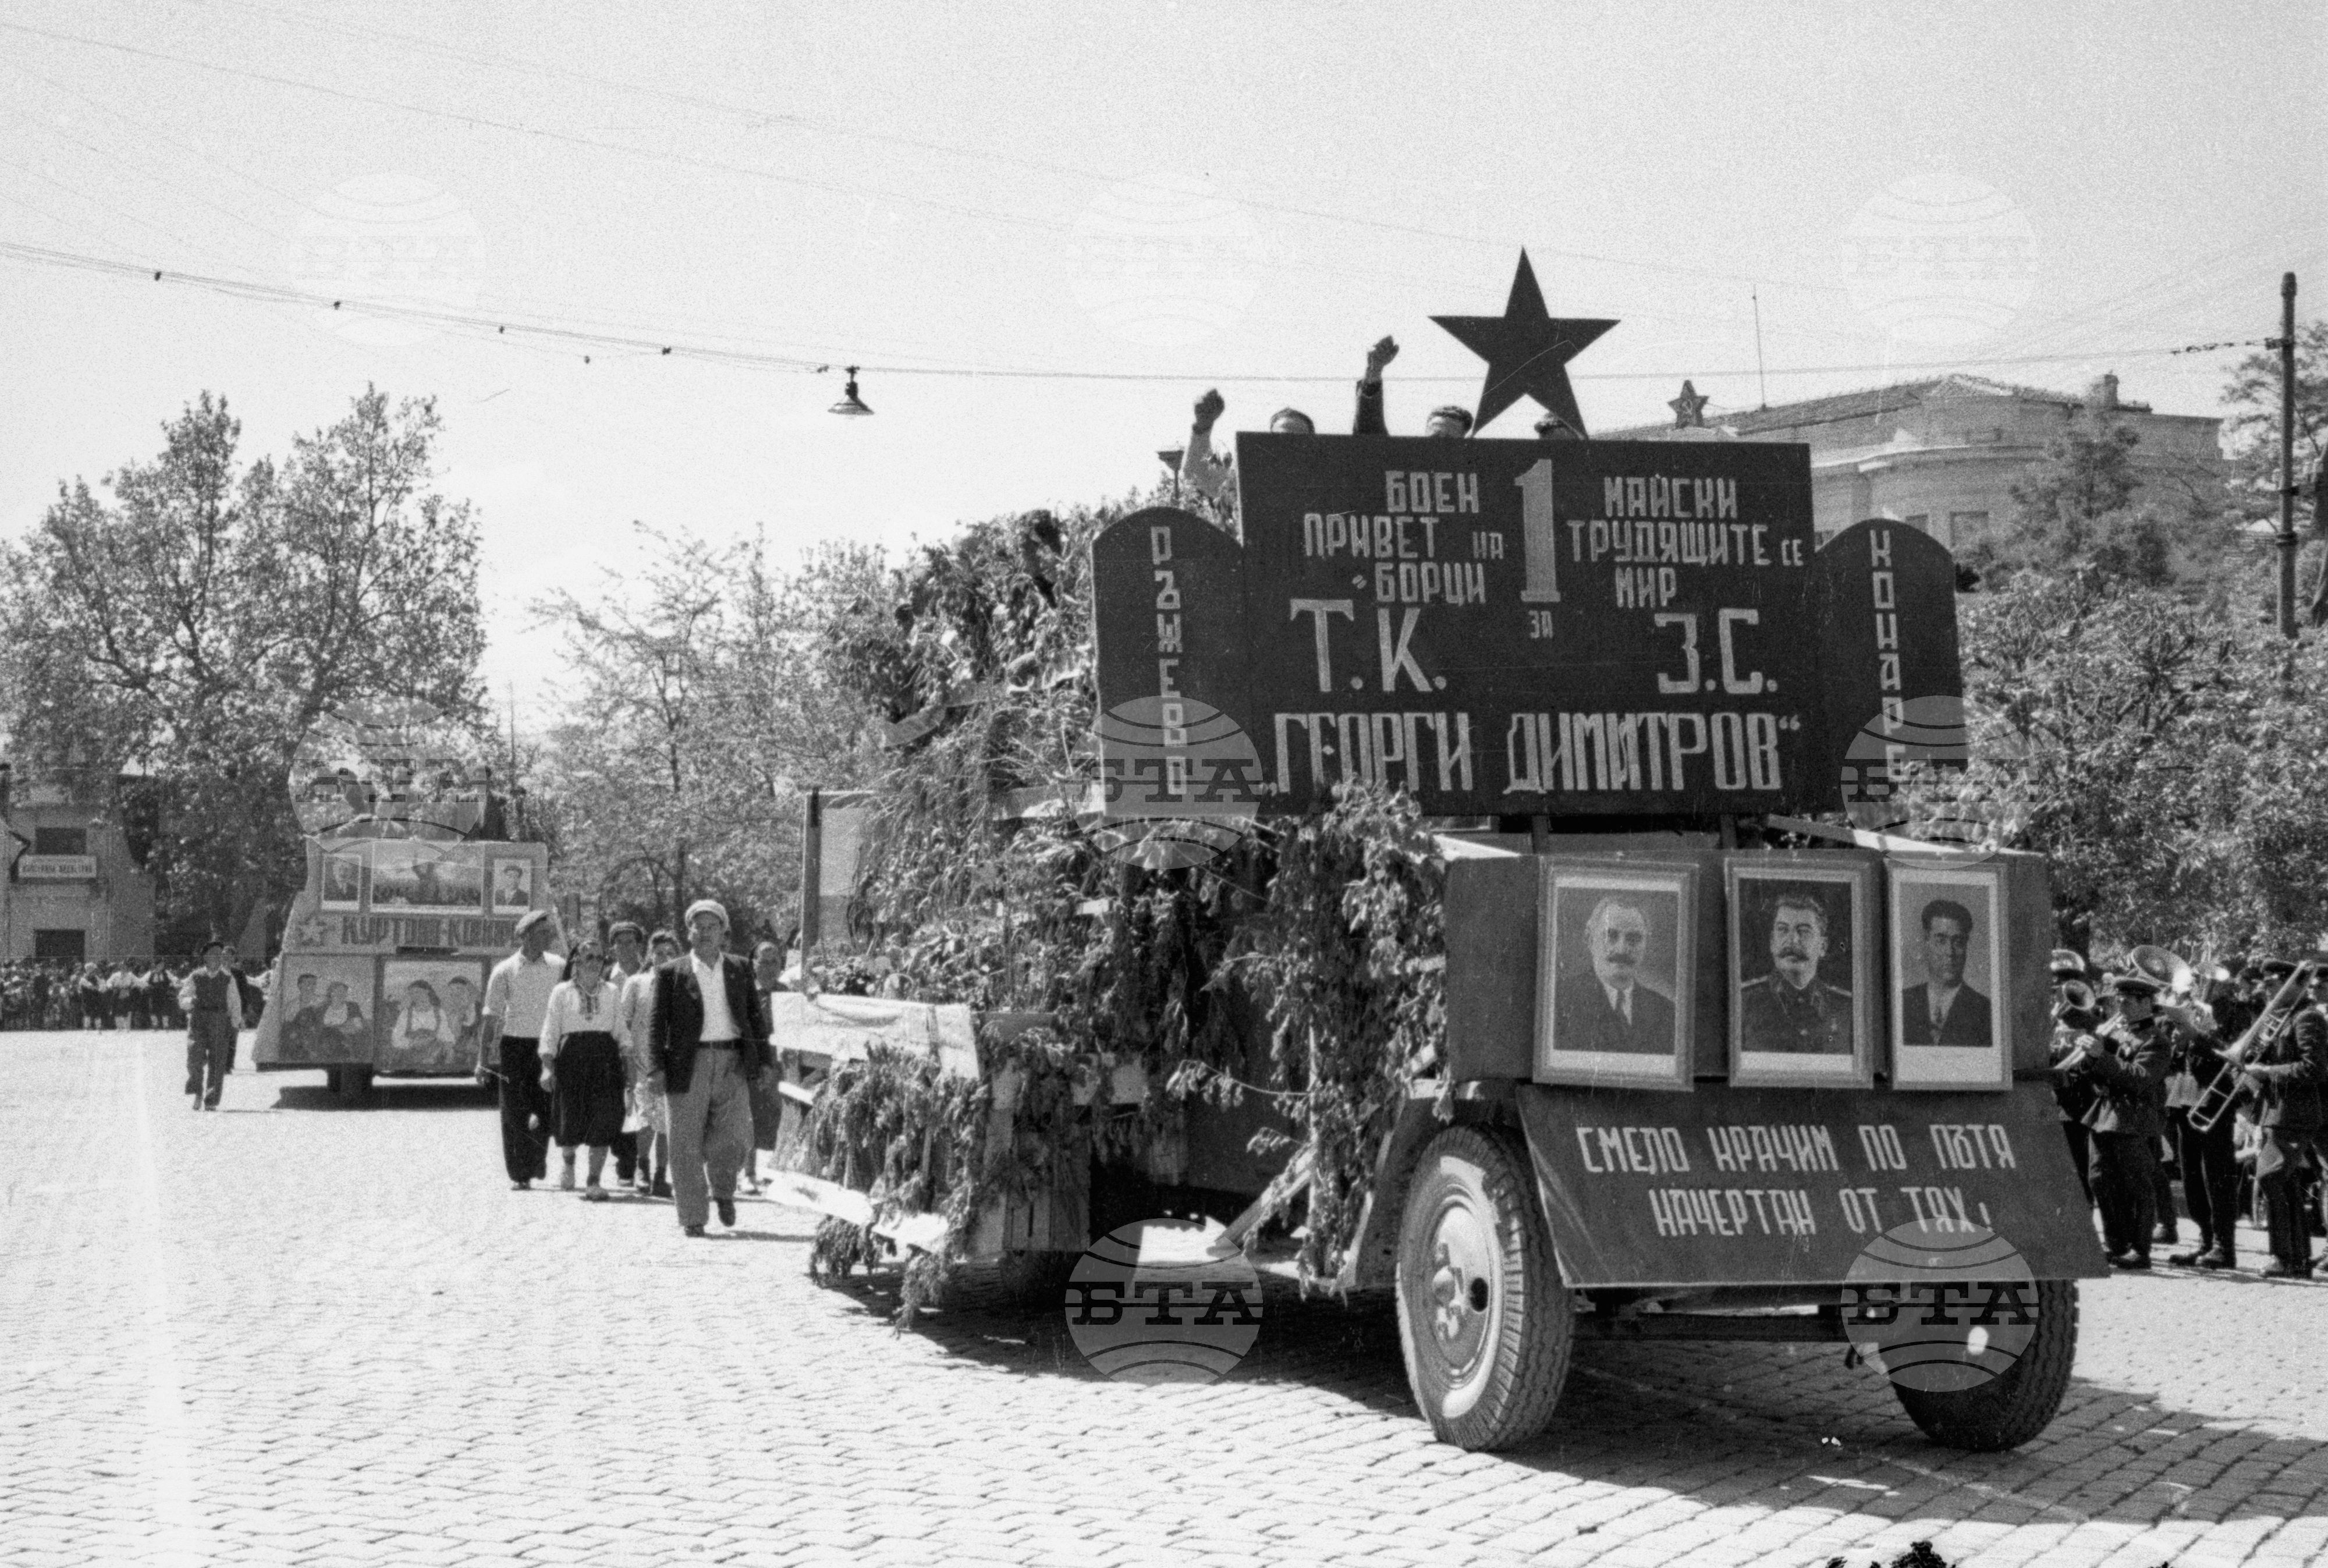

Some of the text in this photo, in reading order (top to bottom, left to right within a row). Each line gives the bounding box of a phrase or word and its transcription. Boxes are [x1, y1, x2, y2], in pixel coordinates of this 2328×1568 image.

[1304, 513, 1803, 566] ПРИВЕТ НА ТРУДЯЩИТЕ СЕ
[1386, 459, 1737, 602] БОЕН 1 МАЙСКИ
[1529, 611, 1553, 638] ЗА
[1615, 567, 1676, 608] МИР
[1151, 526, 1187, 795] РАЖЕВО
[1870, 529, 1906, 782] КОНАРЕ
[1576, 1126, 1691, 1175] СМЕЛО
[1708, 1125, 1839, 1172] КРАЧИМ
[1858, 1125, 1907, 1171] ПО
[1648, 1186, 1993, 1237] НАЧЕРТАН ОТ ТЯХ!
